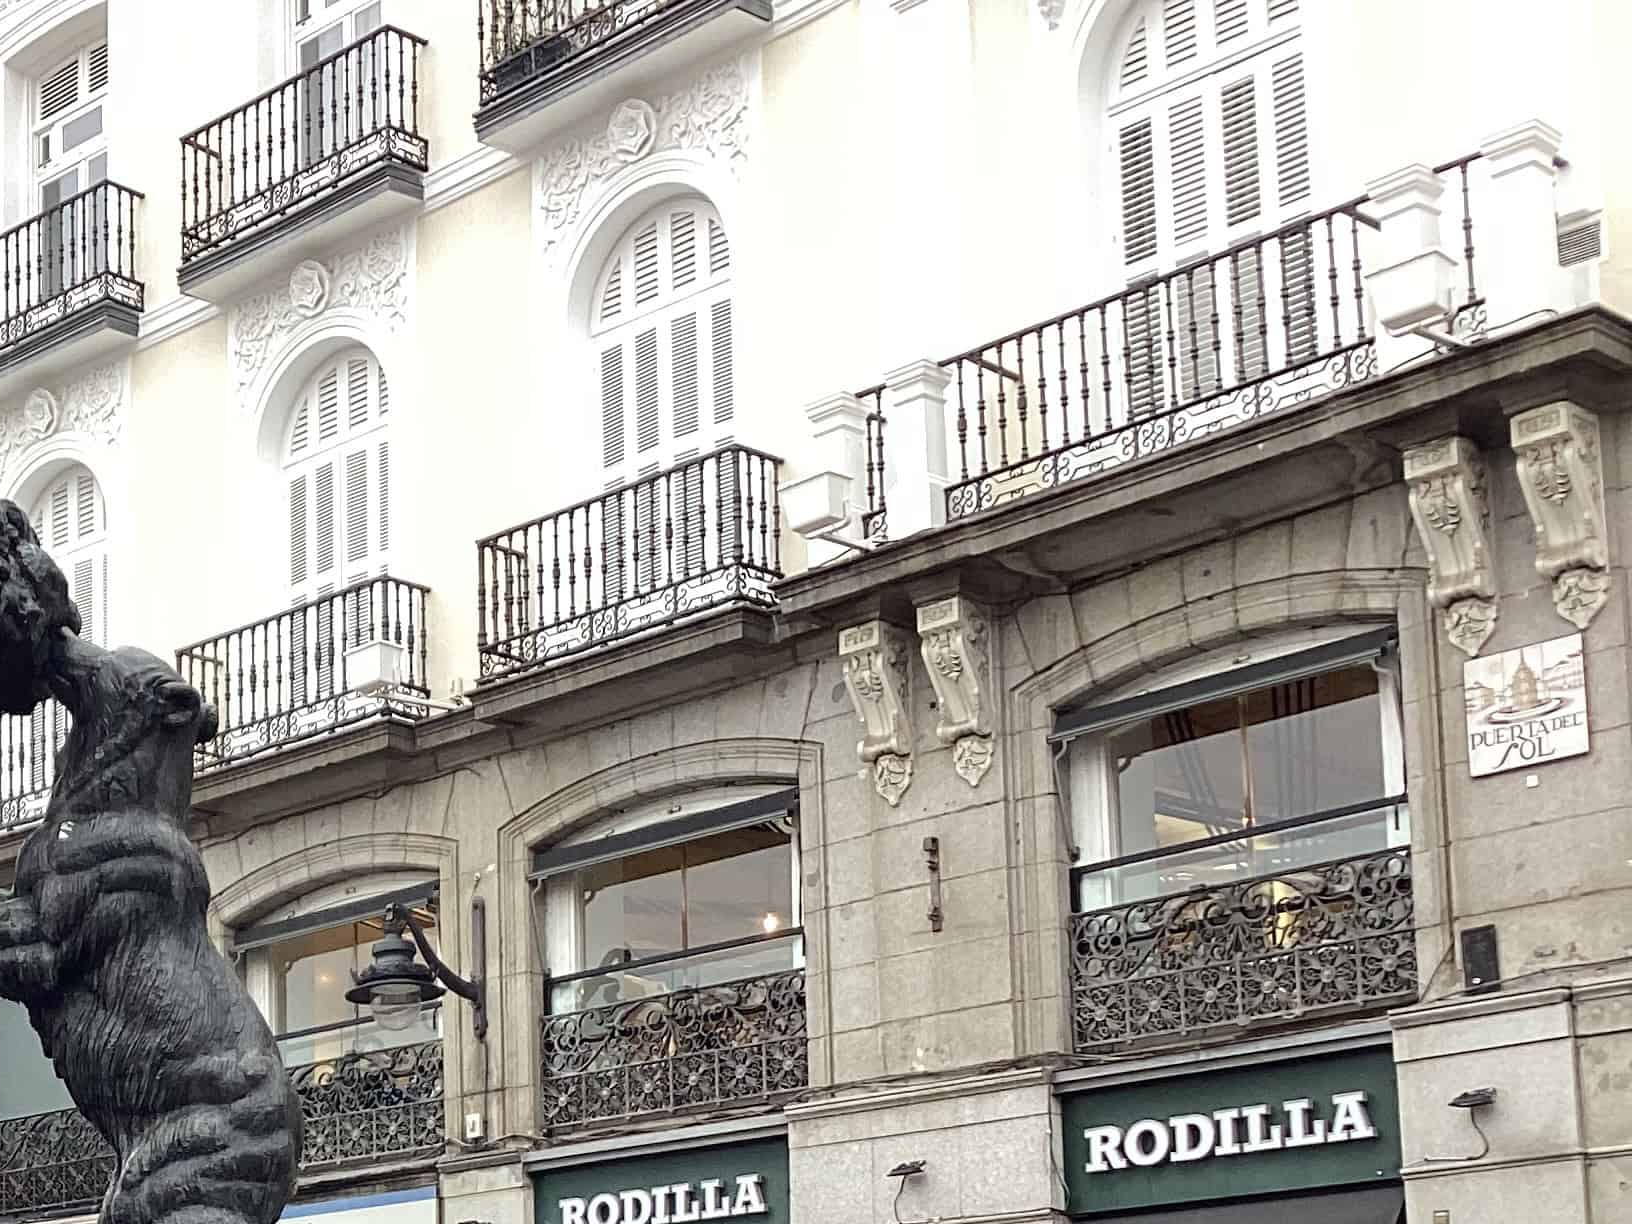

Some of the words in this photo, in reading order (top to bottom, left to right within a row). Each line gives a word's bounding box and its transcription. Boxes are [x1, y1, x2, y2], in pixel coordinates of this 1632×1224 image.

[1470, 719, 1550, 750] PUERTA
[1552, 711, 1586, 731] DEL
[1491, 737, 1556, 769] SOL
[1084, 1090, 1376, 1173] RODILLA
